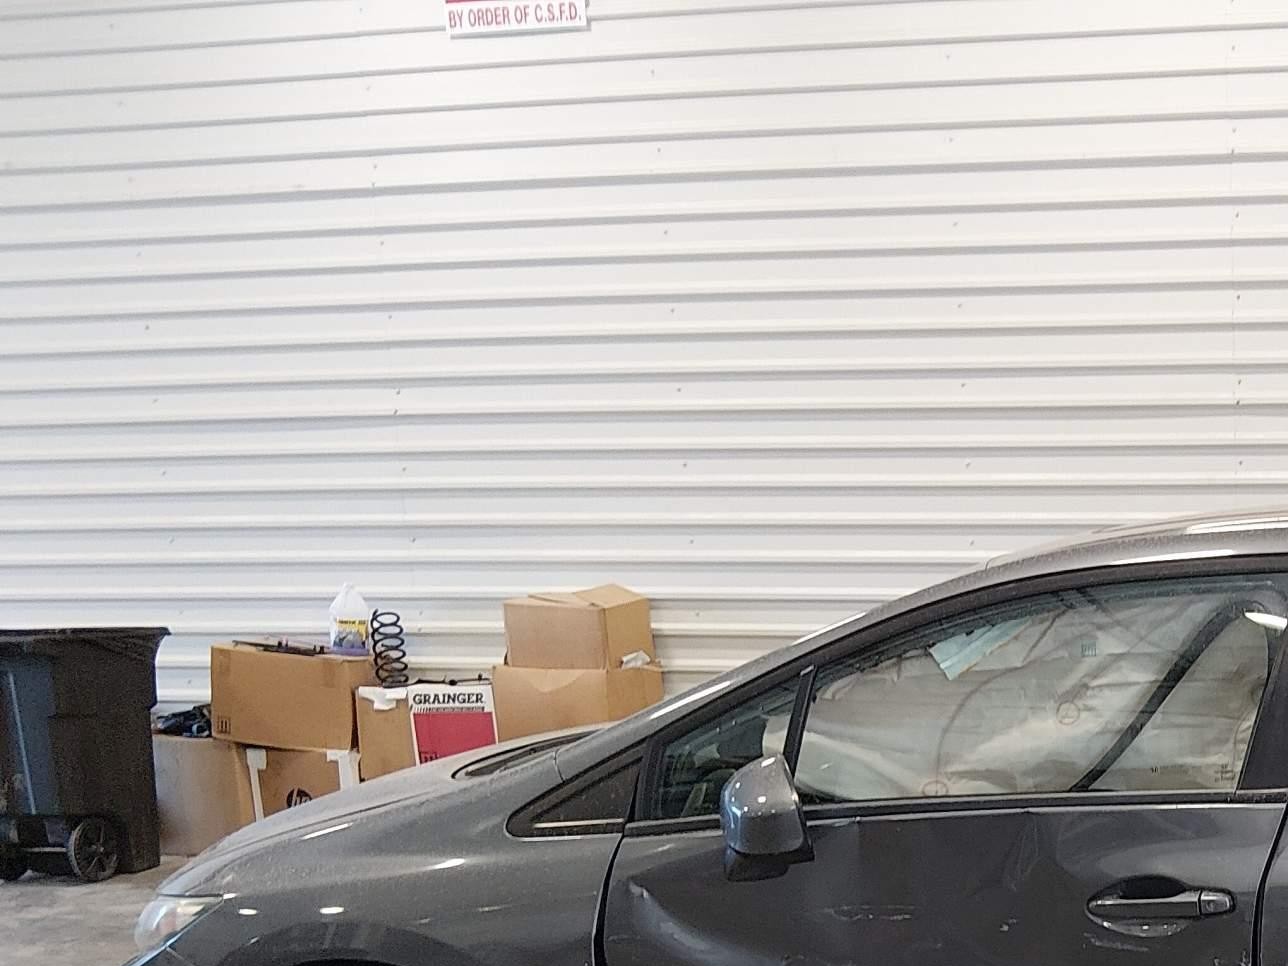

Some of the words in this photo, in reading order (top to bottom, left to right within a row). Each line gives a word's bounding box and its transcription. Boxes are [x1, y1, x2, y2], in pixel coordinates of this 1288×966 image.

[448, 10, 464, 29] BY
[468, 7, 510, 27] ORDER
[514, 5, 530, 24] OF
[535, 2, 583, 23] C.S.F.D.
[412, 692, 484, 705] GRAINGER
